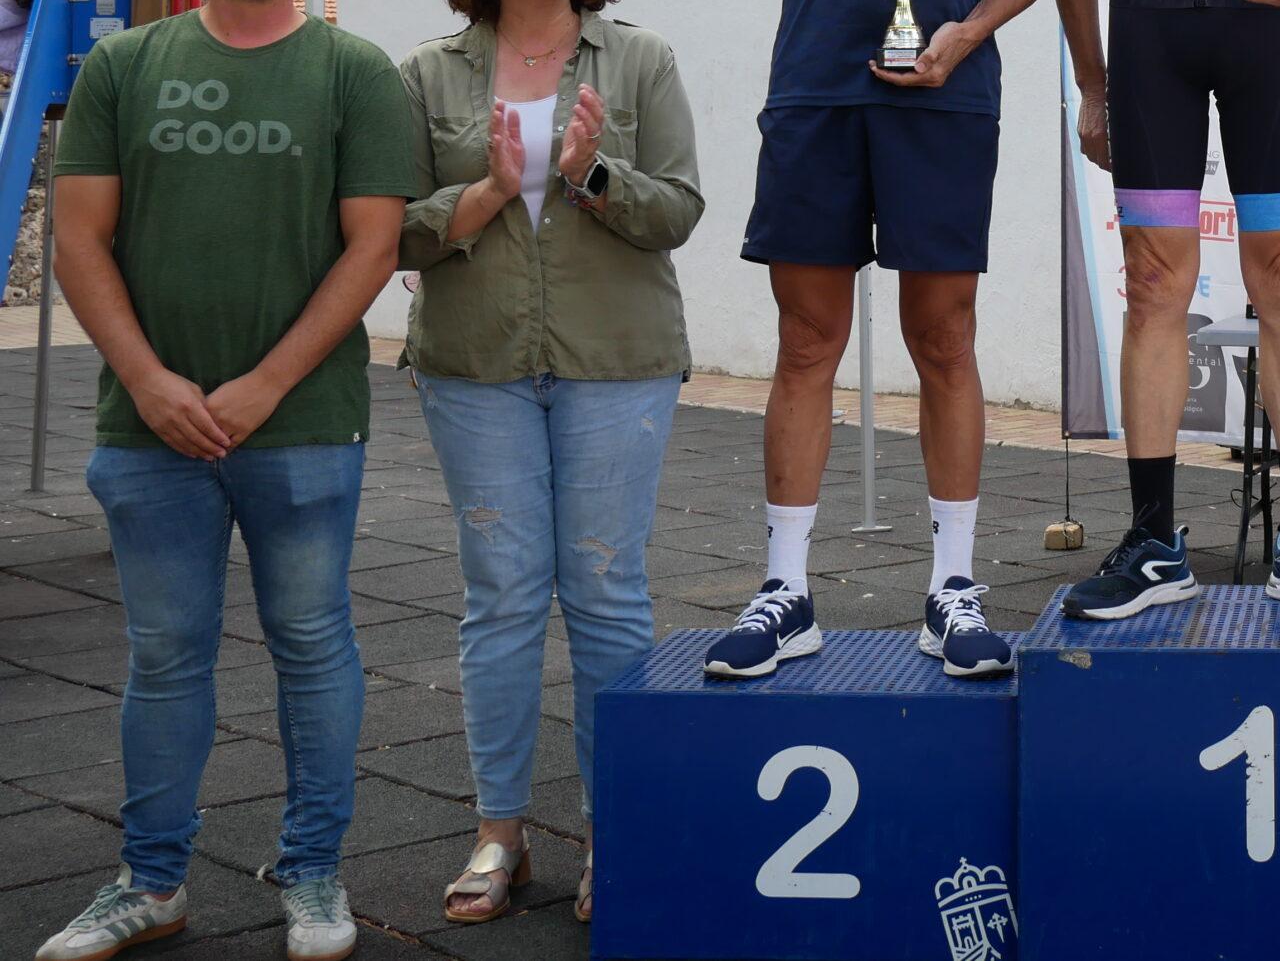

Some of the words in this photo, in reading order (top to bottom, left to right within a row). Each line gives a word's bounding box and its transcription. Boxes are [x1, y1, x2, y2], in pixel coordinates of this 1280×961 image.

[149, 119, 302, 157] GOOD.
[156, 79, 230, 111] DO
[755, 744, 862, 900] 2
[1198, 703, 1276, 864] 1
